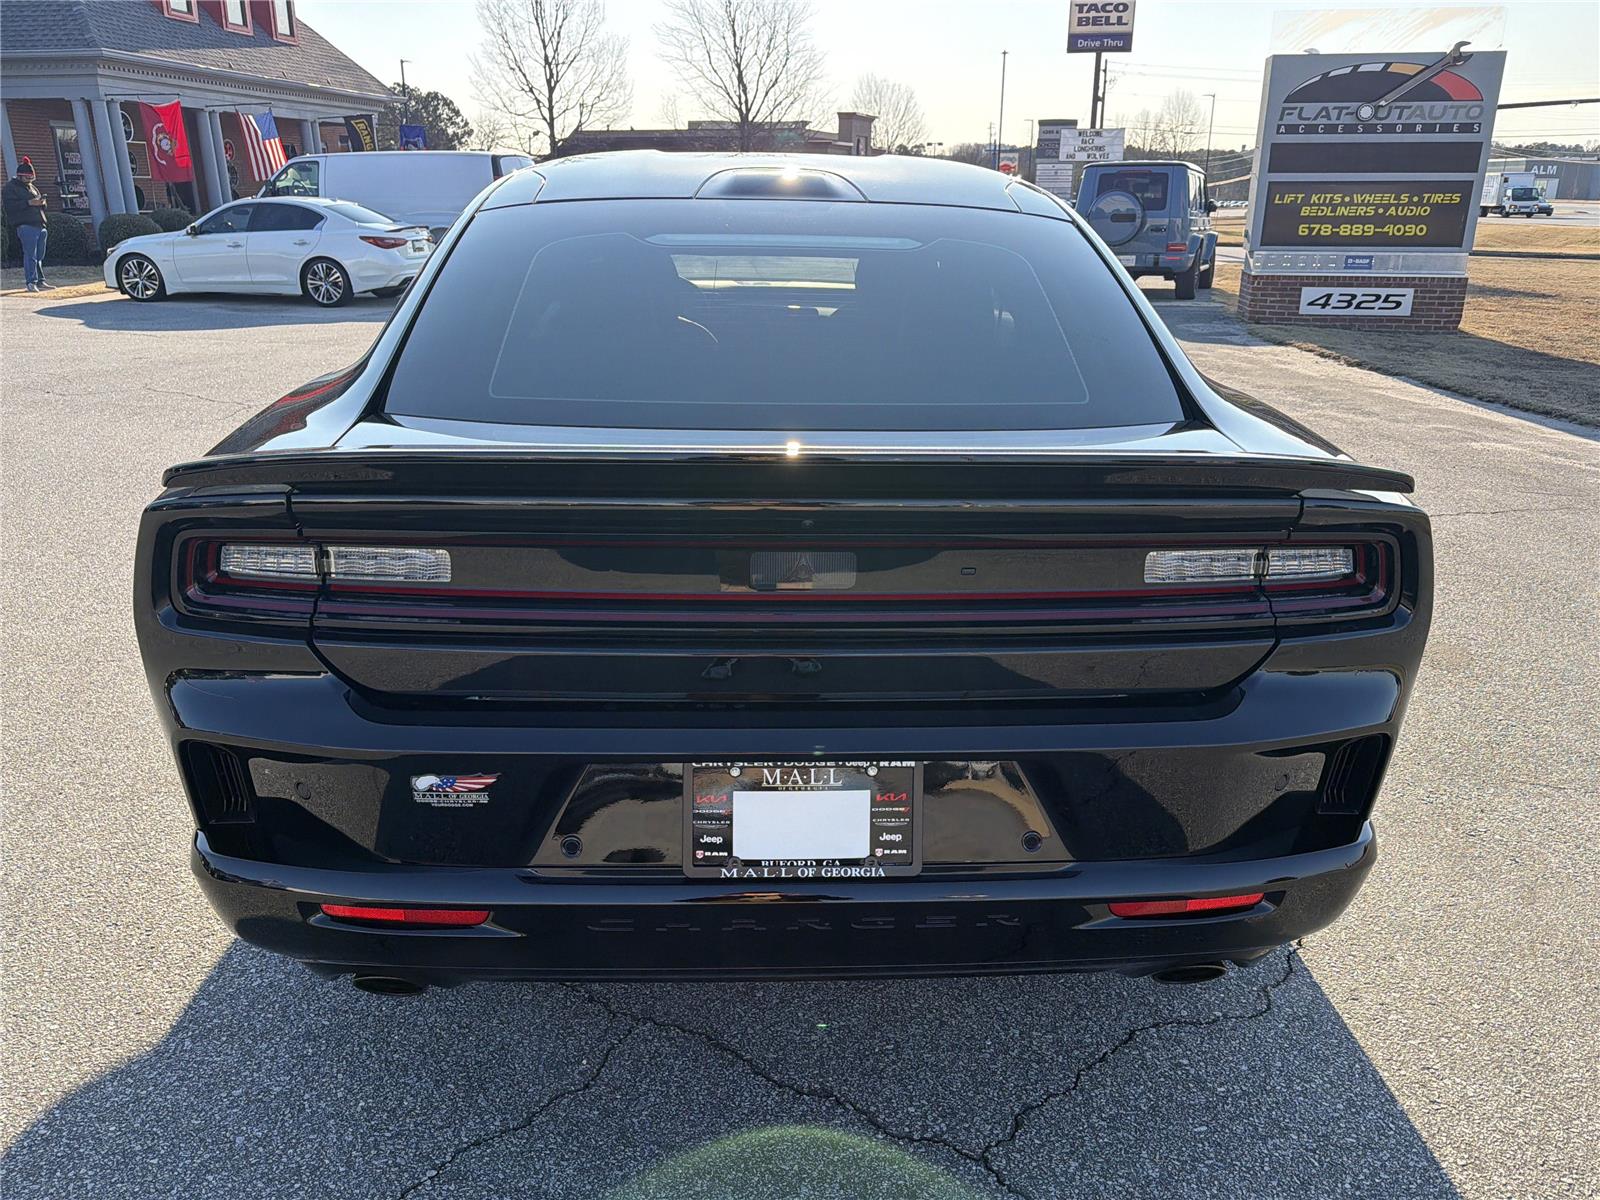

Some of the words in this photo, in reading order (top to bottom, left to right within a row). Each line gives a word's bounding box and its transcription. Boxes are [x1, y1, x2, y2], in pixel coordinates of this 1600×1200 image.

[1075, 2, 1130, 14] TACO
[1076, 15, 1129, 27] BELL
[1077, 39, 1101, 48] Drive
[1103, 38, 1123, 48] Thru
[1279, 123, 1480, 133] ACCESSORIES
[1531, 165, 1558, 175] ALM
[1274, 193, 1305, 204] LIFT
[1310, 193, 1343, 204] KITS
[1353, 193, 1410, 204] WHEELS
[1422, 193, 1462, 204] TIRES
[1300, 206, 1376, 216] BEDLINERS
[1386, 206, 1432, 216] AUDIO
[1298, 224, 1428, 236] 678-889-4090
[1306, 292, 1408, 311] 4325
[700, 834, 723, 844] Jeep
[879, 832, 903, 842] Jeep
[797, 867, 817, 878] OF
[821, 867, 886, 878] GEORGIA
